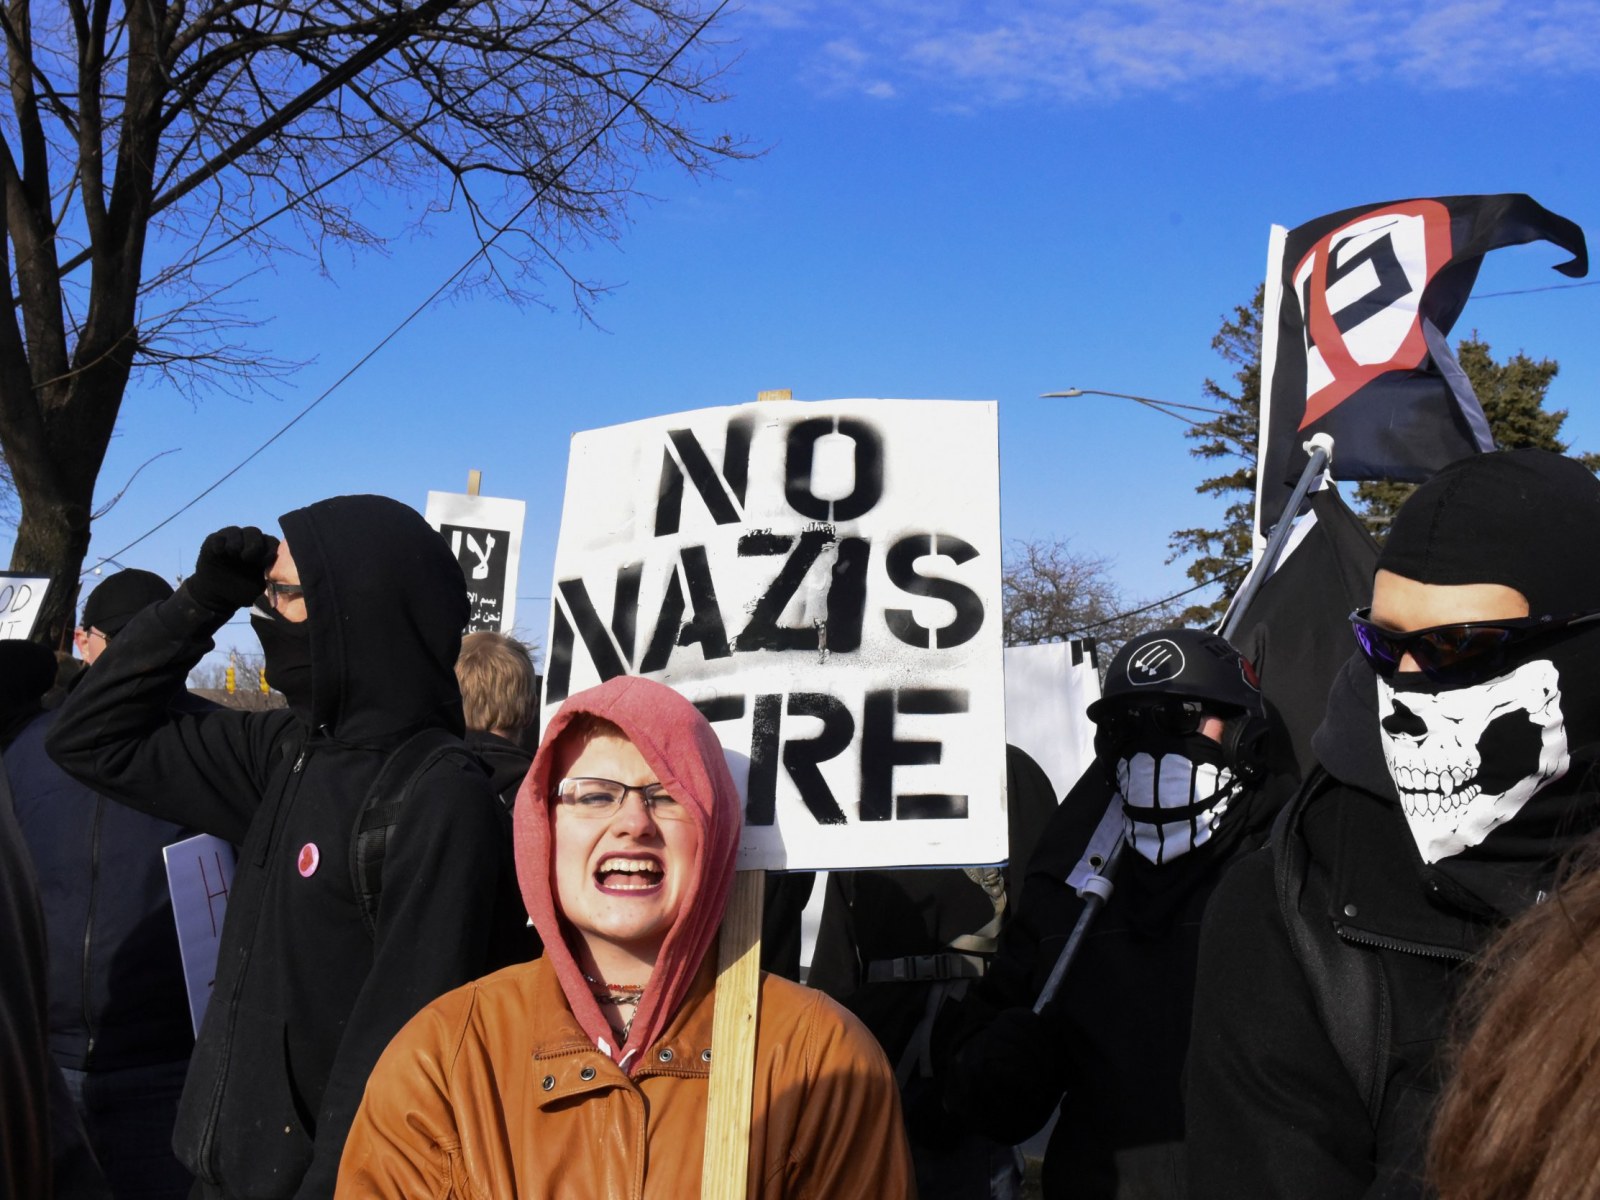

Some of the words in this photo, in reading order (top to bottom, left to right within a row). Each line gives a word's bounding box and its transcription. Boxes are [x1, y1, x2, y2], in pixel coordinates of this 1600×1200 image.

[653, 413, 886, 538] NO
[482, 611, 501, 623] نحن
[545, 522, 985, 706] NAZIS
[694, 686, 970, 826] RE
